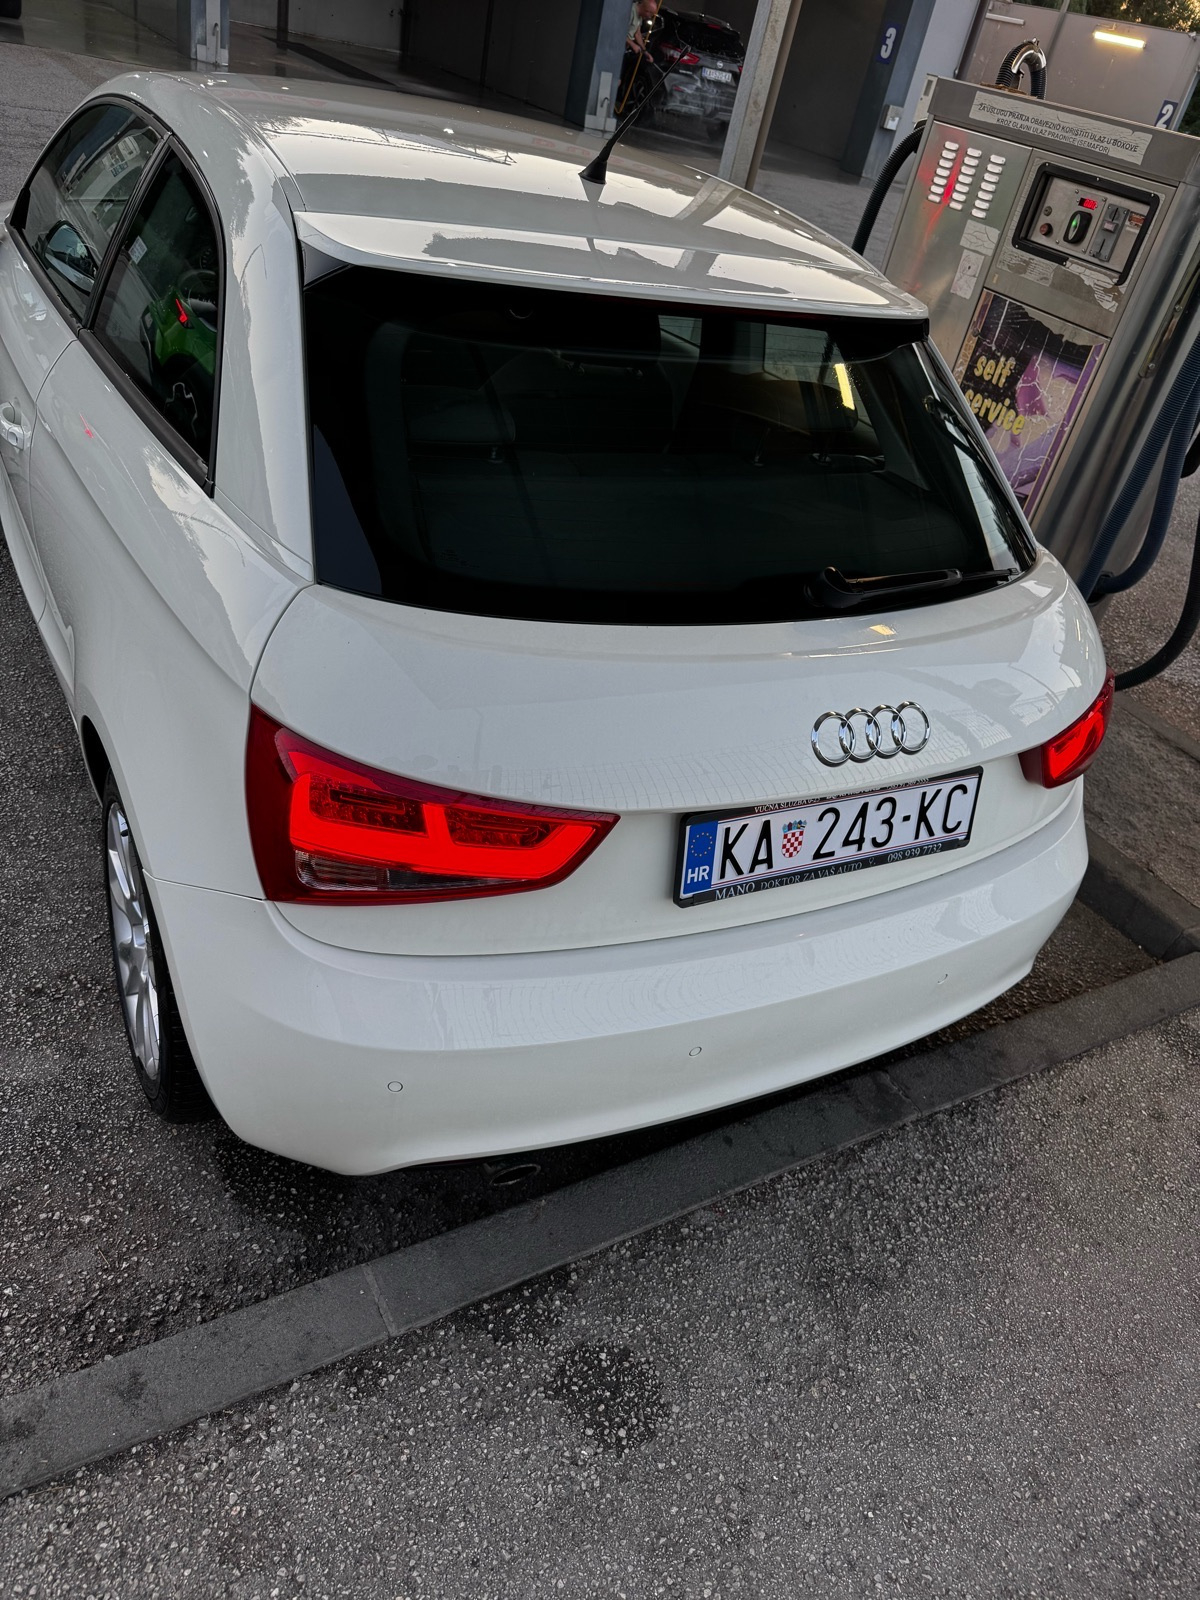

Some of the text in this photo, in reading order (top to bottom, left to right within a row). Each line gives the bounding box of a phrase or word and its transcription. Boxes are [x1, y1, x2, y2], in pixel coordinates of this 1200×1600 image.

[880, 27, 897, 59] 3
[986, 104, 1008, 118] USLUGU
[1007, 110, 1031, 124] PRANJA
[1030, 116, 1061, 132] OBAVEZNO
[1089, 131, 1107, 144] ULAZ
[1112, 138, 1140, 153] BOXOVE
[1155, 103, 1174, 129] 2
[996, 117, 1111, 156] KROZ GLAVNI ULAZ PRAONICE (SEMAFOR)
[974, 355, 1016, 388] self
[964, 389, 1025, 436] service
[754, 803, 780, 814] VUČNA
[719, 783, 968, 880] KA 243-KC
[686, 865, 710, 884] HR
[714, 842, 943, 901] MANO DOKTOR ZA VAŠ AUTO 098 939 7732
